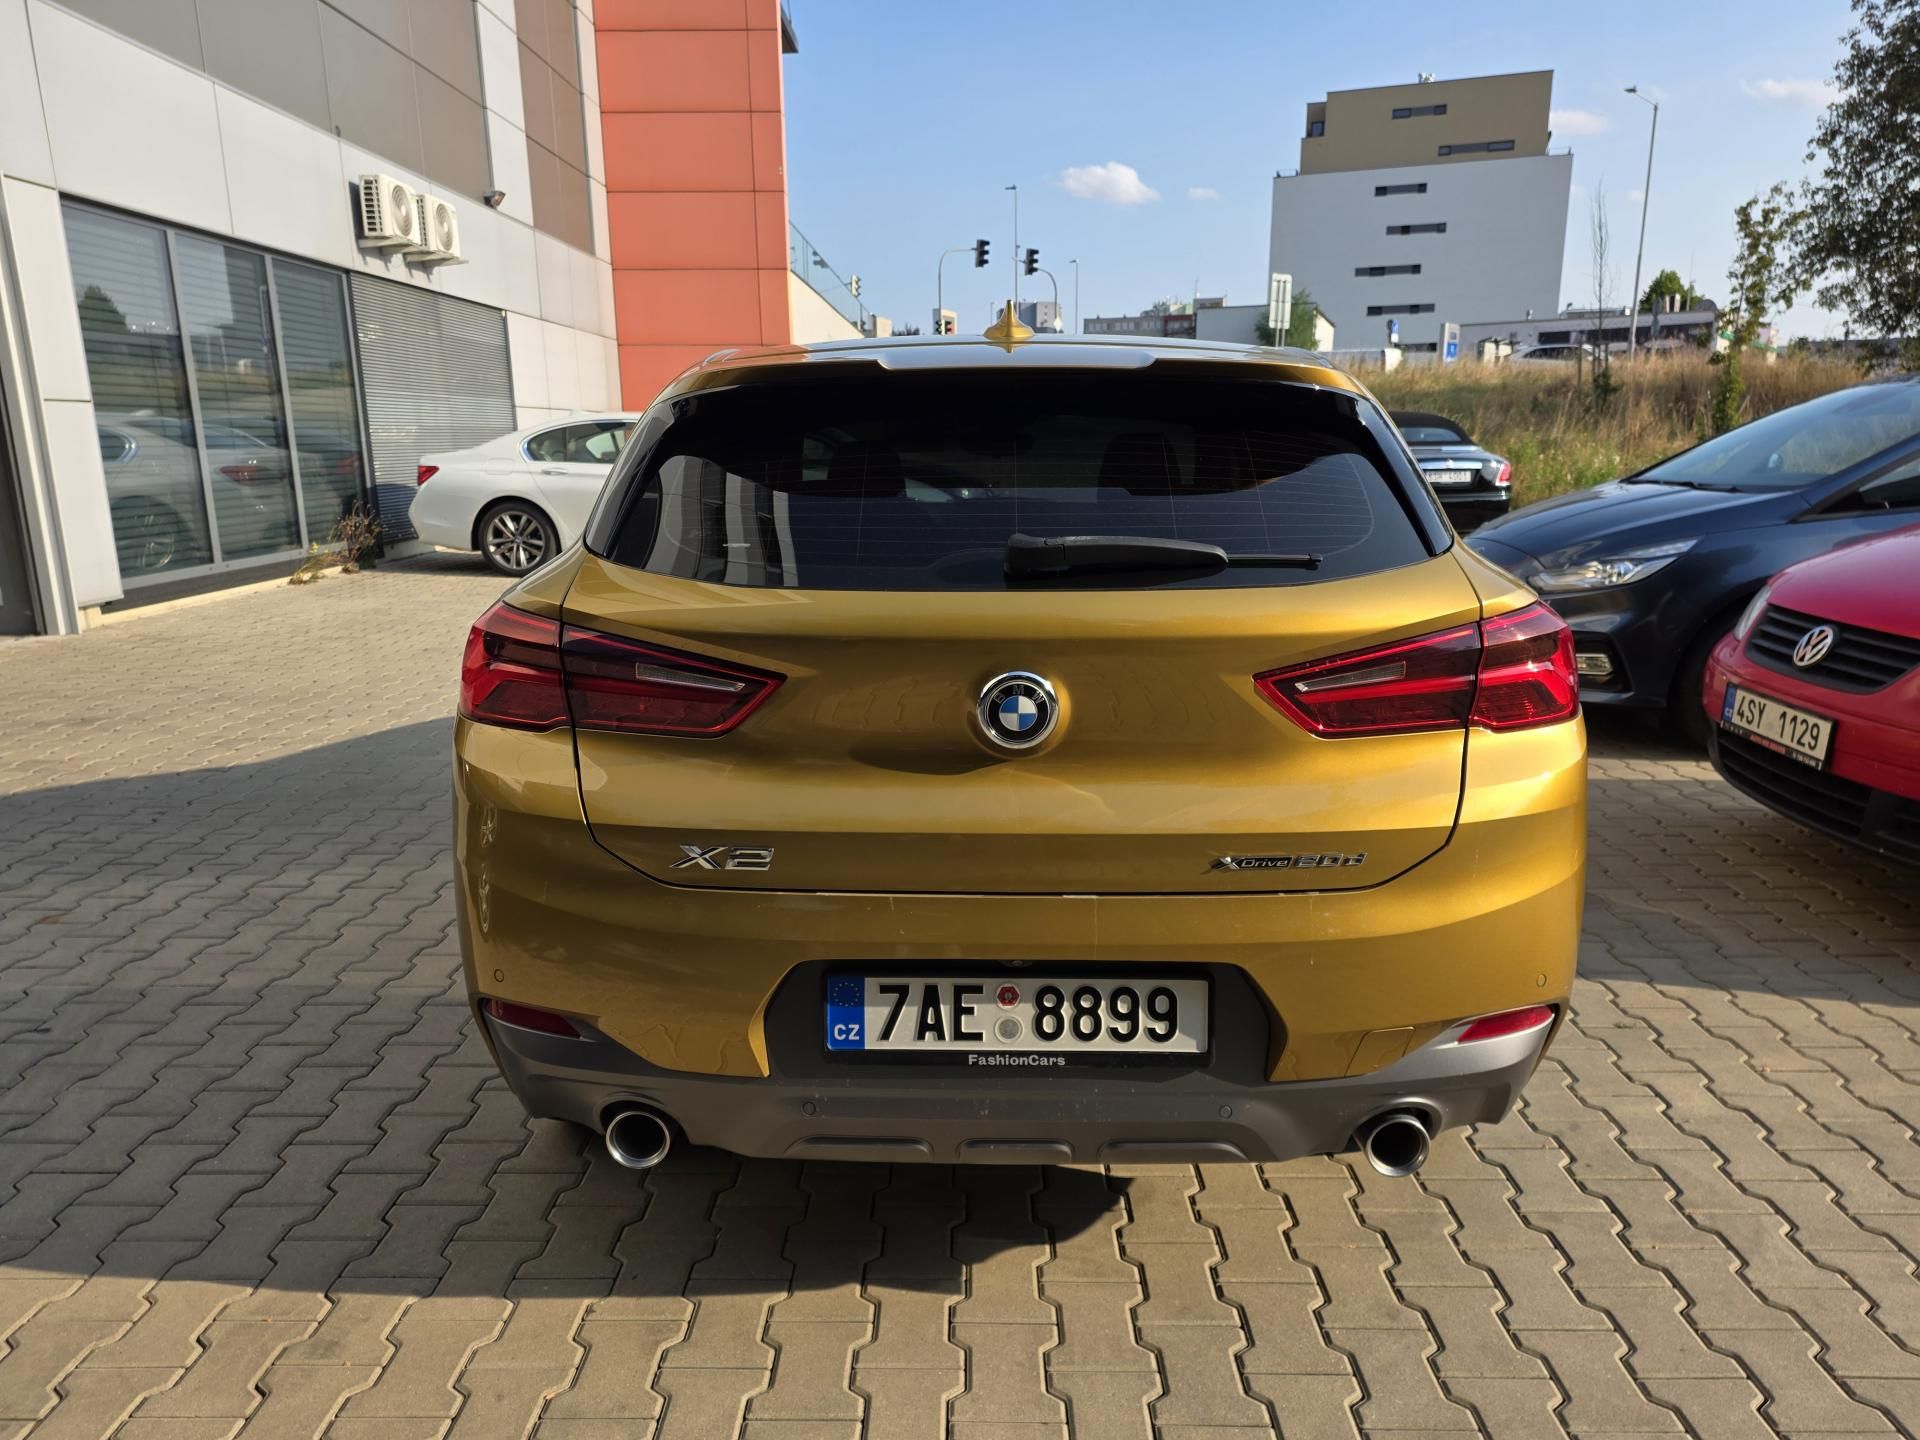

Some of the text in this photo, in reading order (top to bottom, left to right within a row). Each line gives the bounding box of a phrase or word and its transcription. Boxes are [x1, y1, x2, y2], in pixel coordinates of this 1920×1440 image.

[993, 684, 1045, 704] BMW
[1736, 695, 1767, 729] 4SY
[1779, 710, 1821, 751] 1129
[668, 845, 774, 871] X2
[877, 984, 1179, 1042] 7AE 8899
[833, 1024, 860, 1041] CZ
[968, 1054, 1066, 1066] FashionCars
